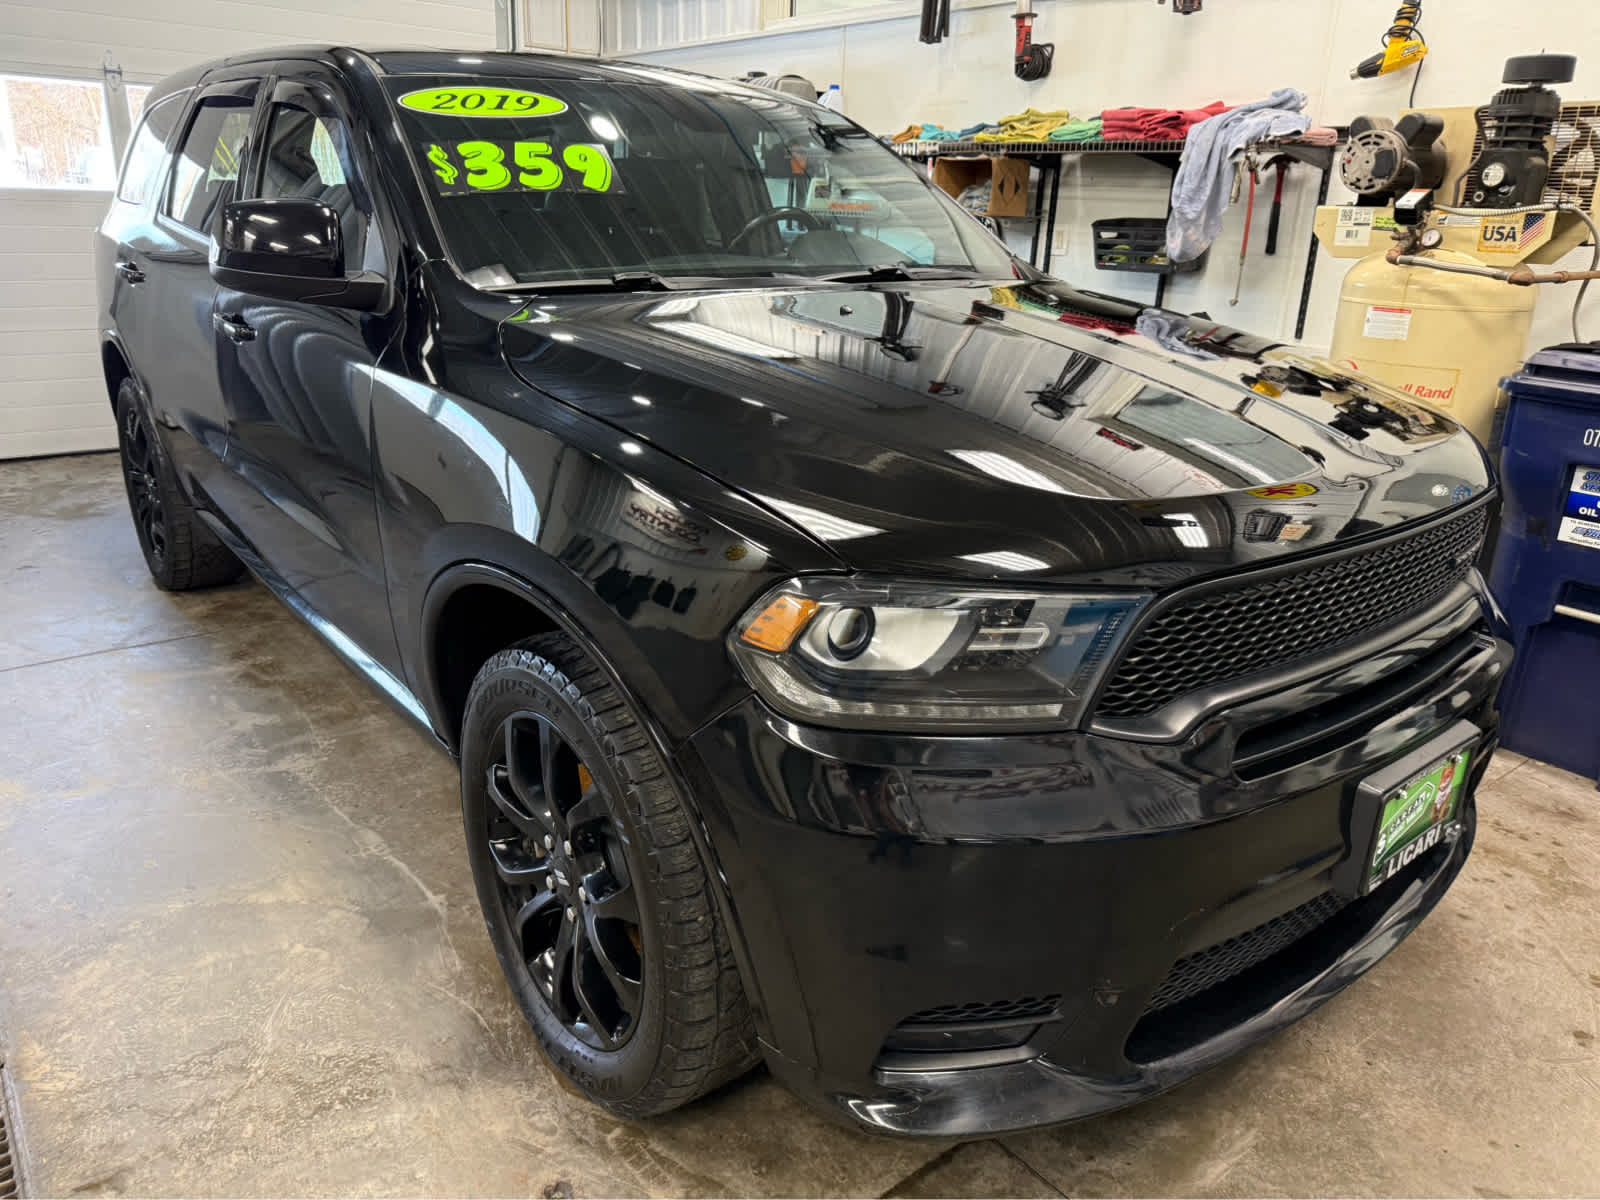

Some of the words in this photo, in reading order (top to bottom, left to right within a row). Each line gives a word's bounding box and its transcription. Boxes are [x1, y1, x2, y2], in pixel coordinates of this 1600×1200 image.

[432, 93, 540, 112] 2019
[427, 141, 612, 192] $359
[1482, 225, 1517, 242] USA
[1414, 385, 1453, 400] Rand
[1578, 506, 1598, 518] OIL
[1387, 823, 1442, 878] LICARI
